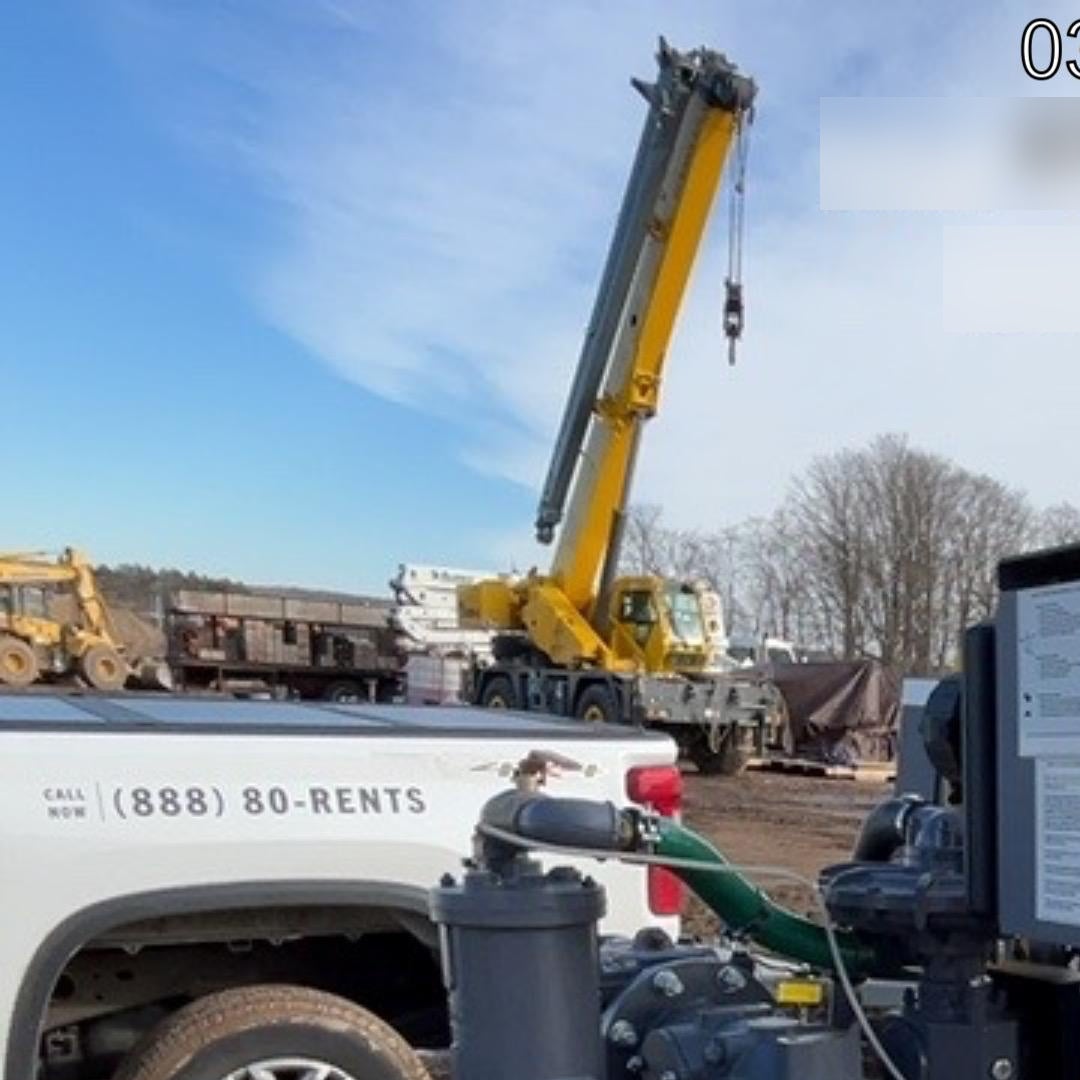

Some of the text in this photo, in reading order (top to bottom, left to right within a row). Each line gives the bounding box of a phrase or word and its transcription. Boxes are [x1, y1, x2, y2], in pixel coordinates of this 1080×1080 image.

[43, 788, 85, 801] CALL
[113, 786, 426, 819] (888) 80-RENTS
[48, 806, 86, 819] NOW
